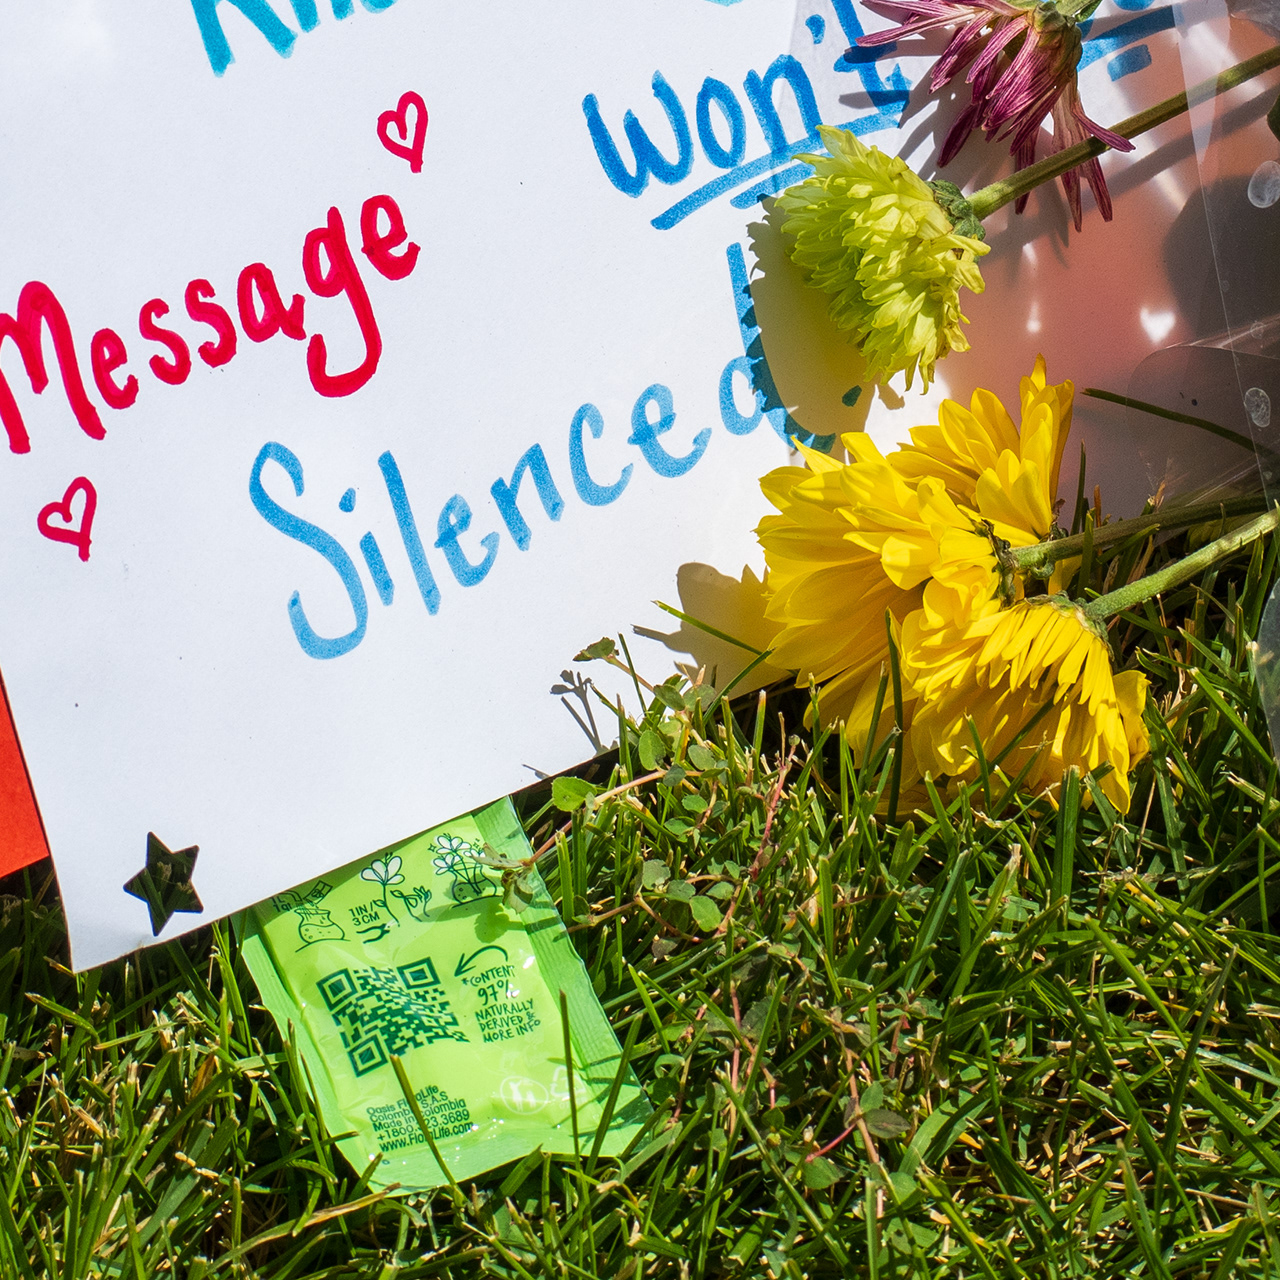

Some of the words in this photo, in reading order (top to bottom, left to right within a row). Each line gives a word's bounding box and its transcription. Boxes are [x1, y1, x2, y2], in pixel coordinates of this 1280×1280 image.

[475, 998, 534, 1022] NATURALLY
[479, 1015, 523, 1032] DERIVED
[483, 1028, 515, 1043] MORE
[516, 1019, 541, 1036] INFO
[366, 1104, 396, 1115] Oasis
[396, 1085, 439, 1109] FlaLife
[372, 1119, 402, 1132] Made
[405, 1115, 416, 1125] in
[379, 1121, 474, 1152] www.FloaLife.com
